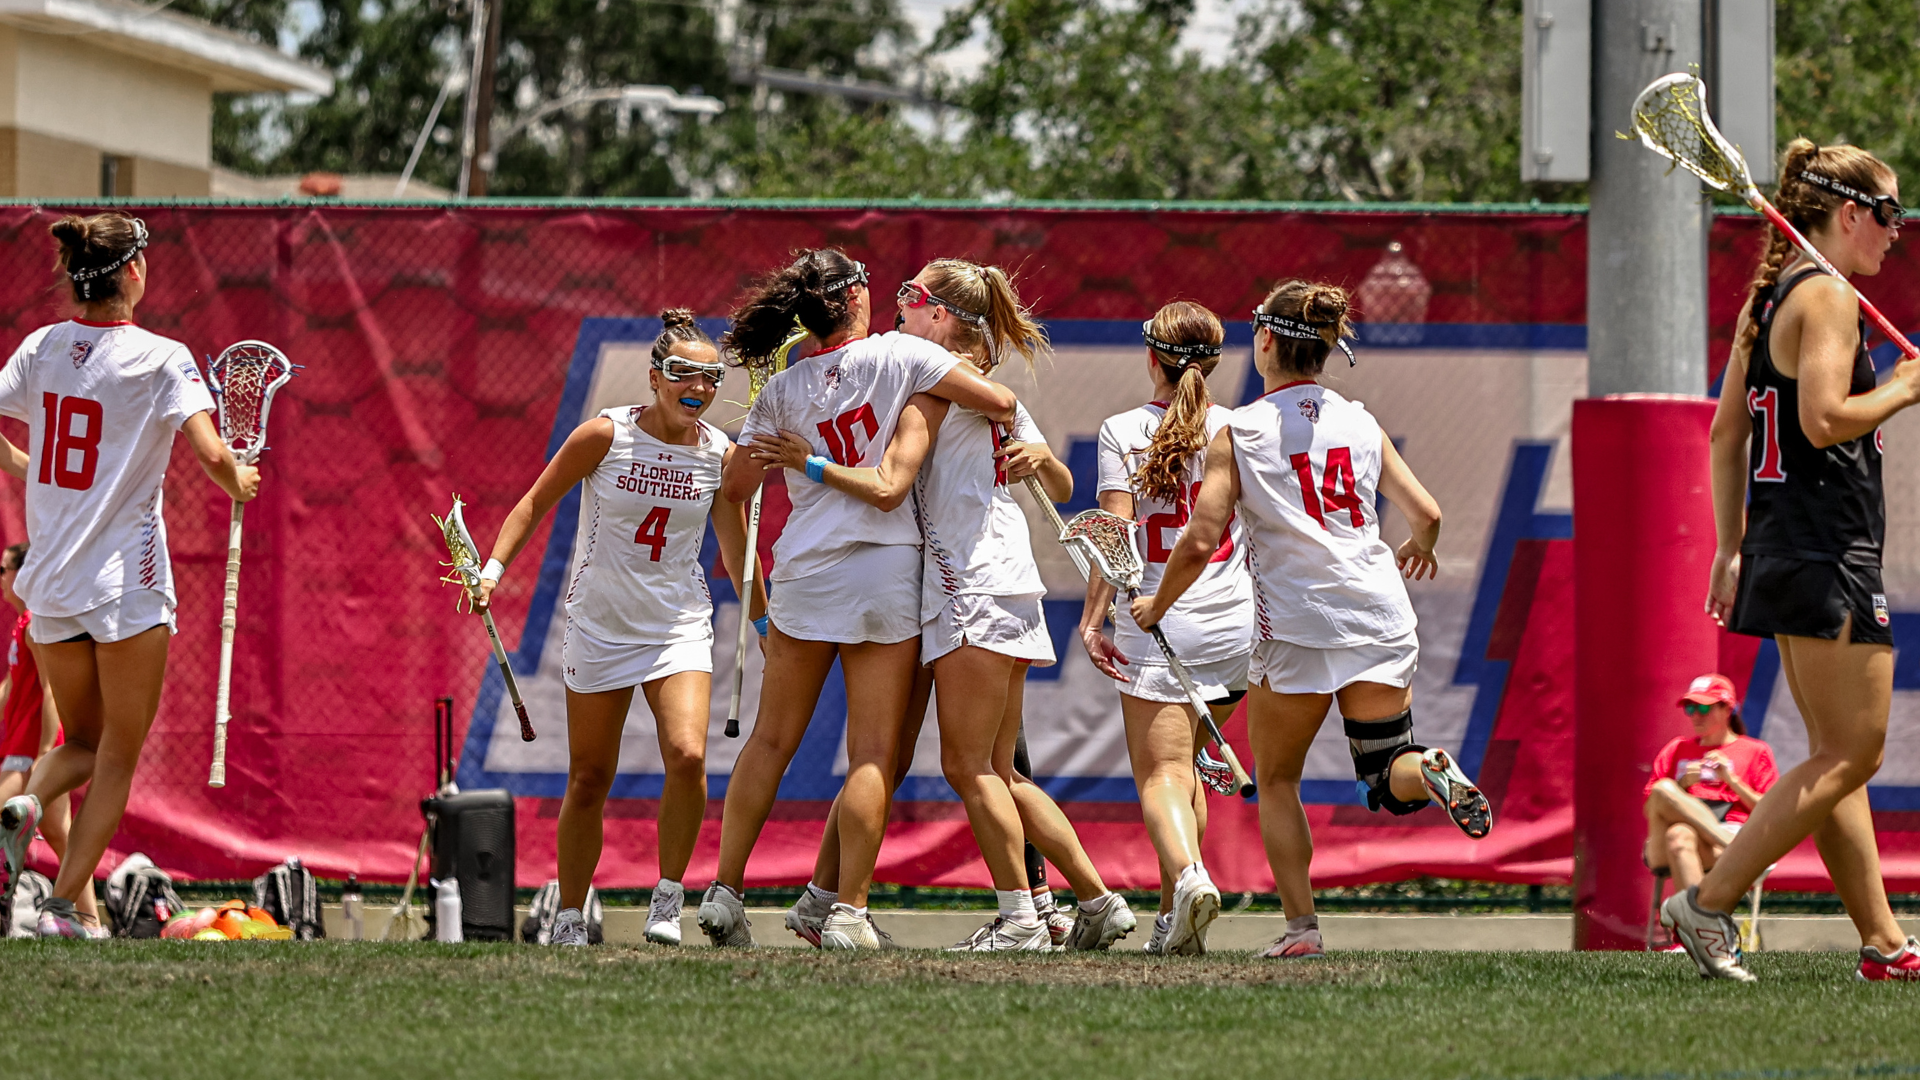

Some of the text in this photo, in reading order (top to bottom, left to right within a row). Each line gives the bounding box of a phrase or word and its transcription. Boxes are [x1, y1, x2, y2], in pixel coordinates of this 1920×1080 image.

[1831, 183, 1857, 197] GAIT
[101, 260, 121, 274] GAIT
[122, 246, 137, 262] GAIT
[826, 273, 859, 292] GAIT GAIT
[1273, 316, 1295, 328] GAIT
[1155, 341, 1171, 350] GAIT
[1173, 346, 1193, 354] GAIT
[38, 391, 103, 491] 18
[629, 462, 694, 485] FLORIDA
[616, 475, 702, 500] SOUTHERN
[1289, 446, 1364, 531] 14
[752, 502, 760, 529] GAIT
[634, 506, 671, 562] 4
